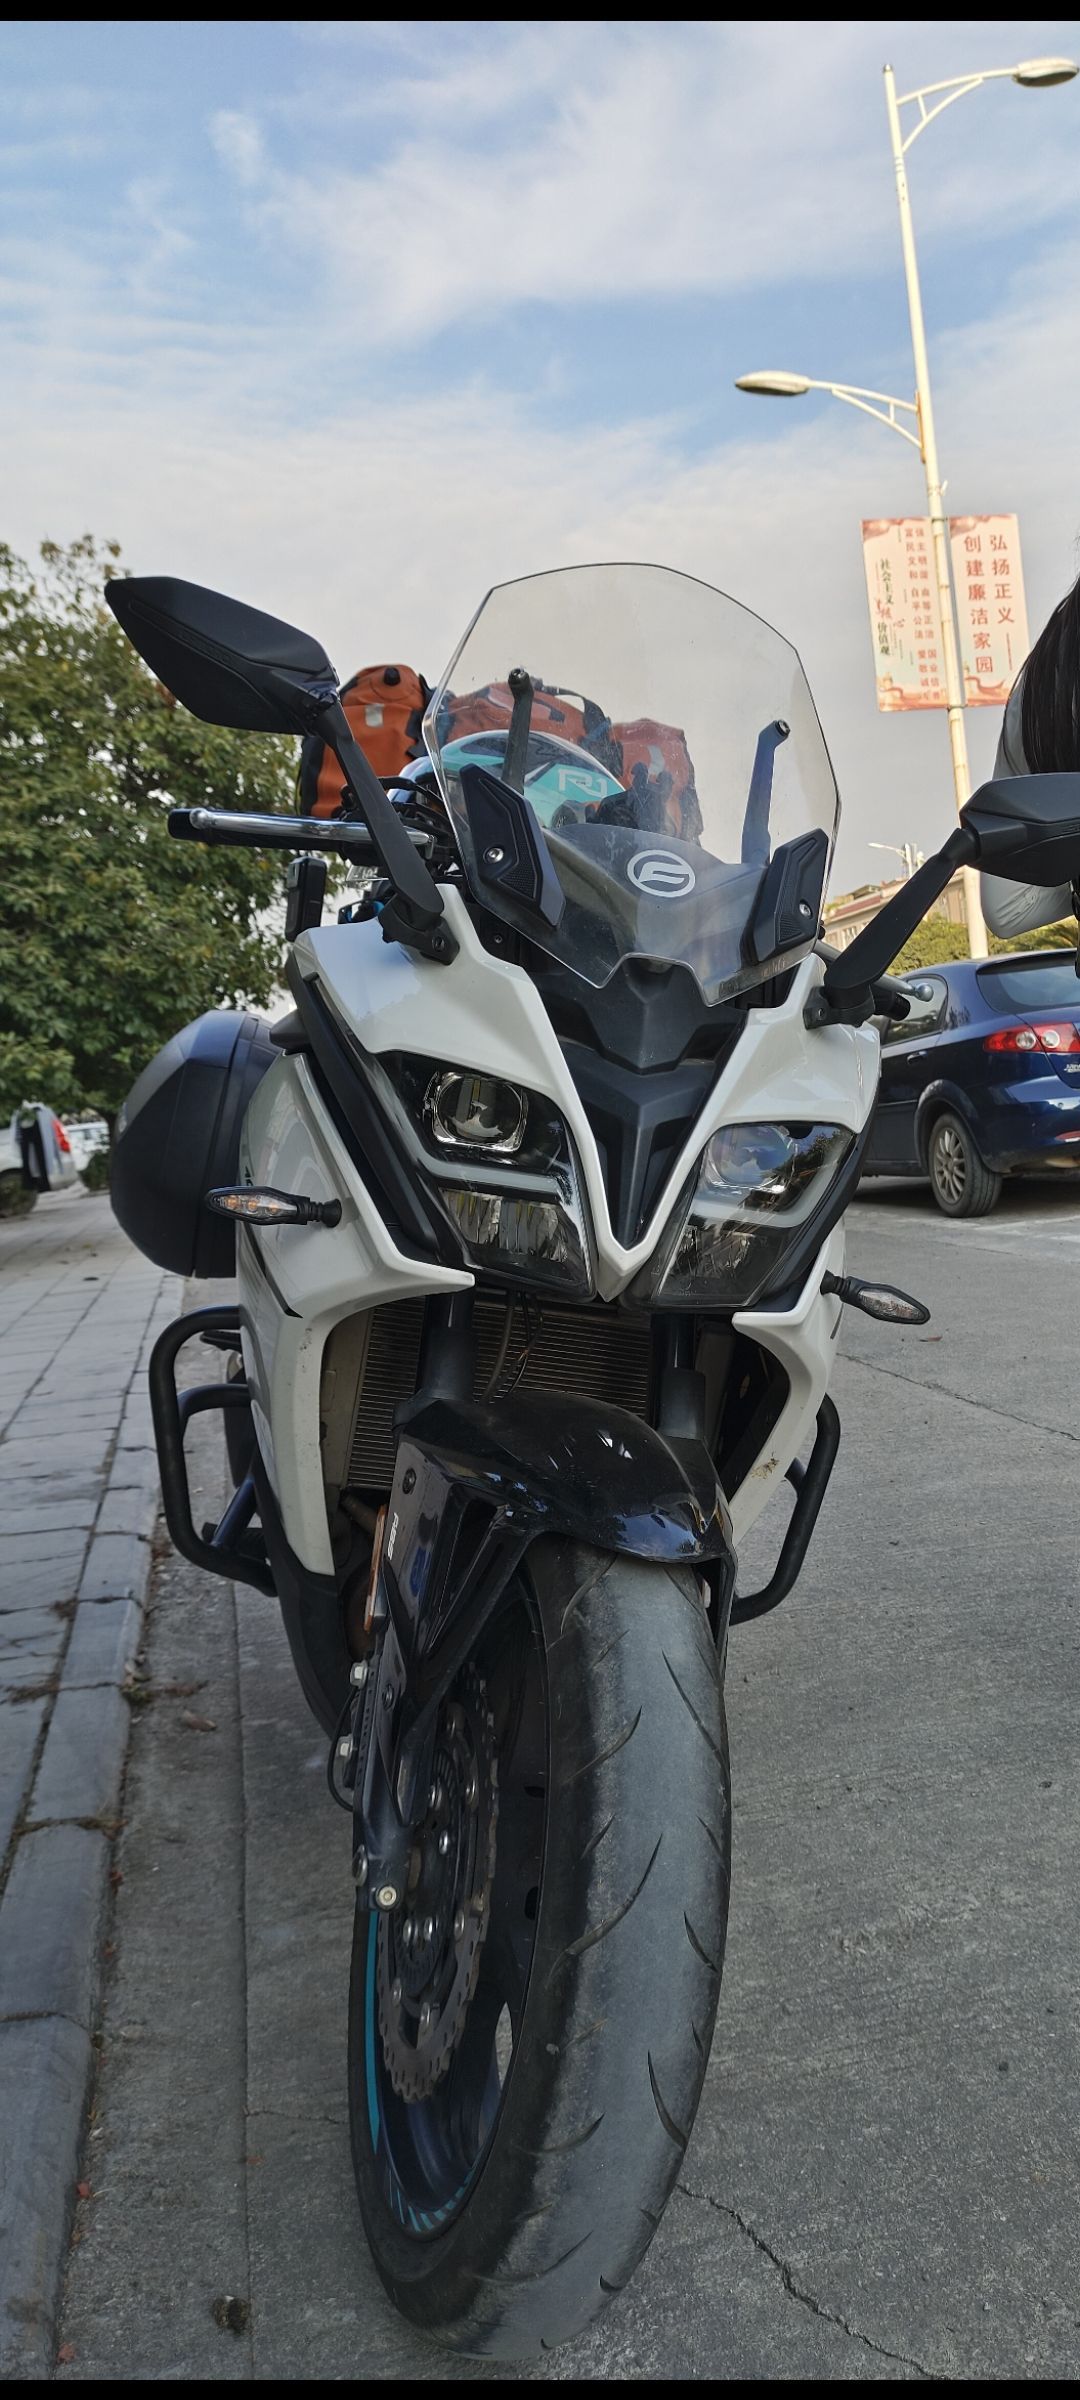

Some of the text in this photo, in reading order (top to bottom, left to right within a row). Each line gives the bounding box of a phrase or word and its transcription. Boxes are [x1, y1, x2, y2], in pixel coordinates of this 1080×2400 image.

[964, 535, 994, 673] 创建廉洁家园
[990, 534, 1015, 624] 弘扬正义
